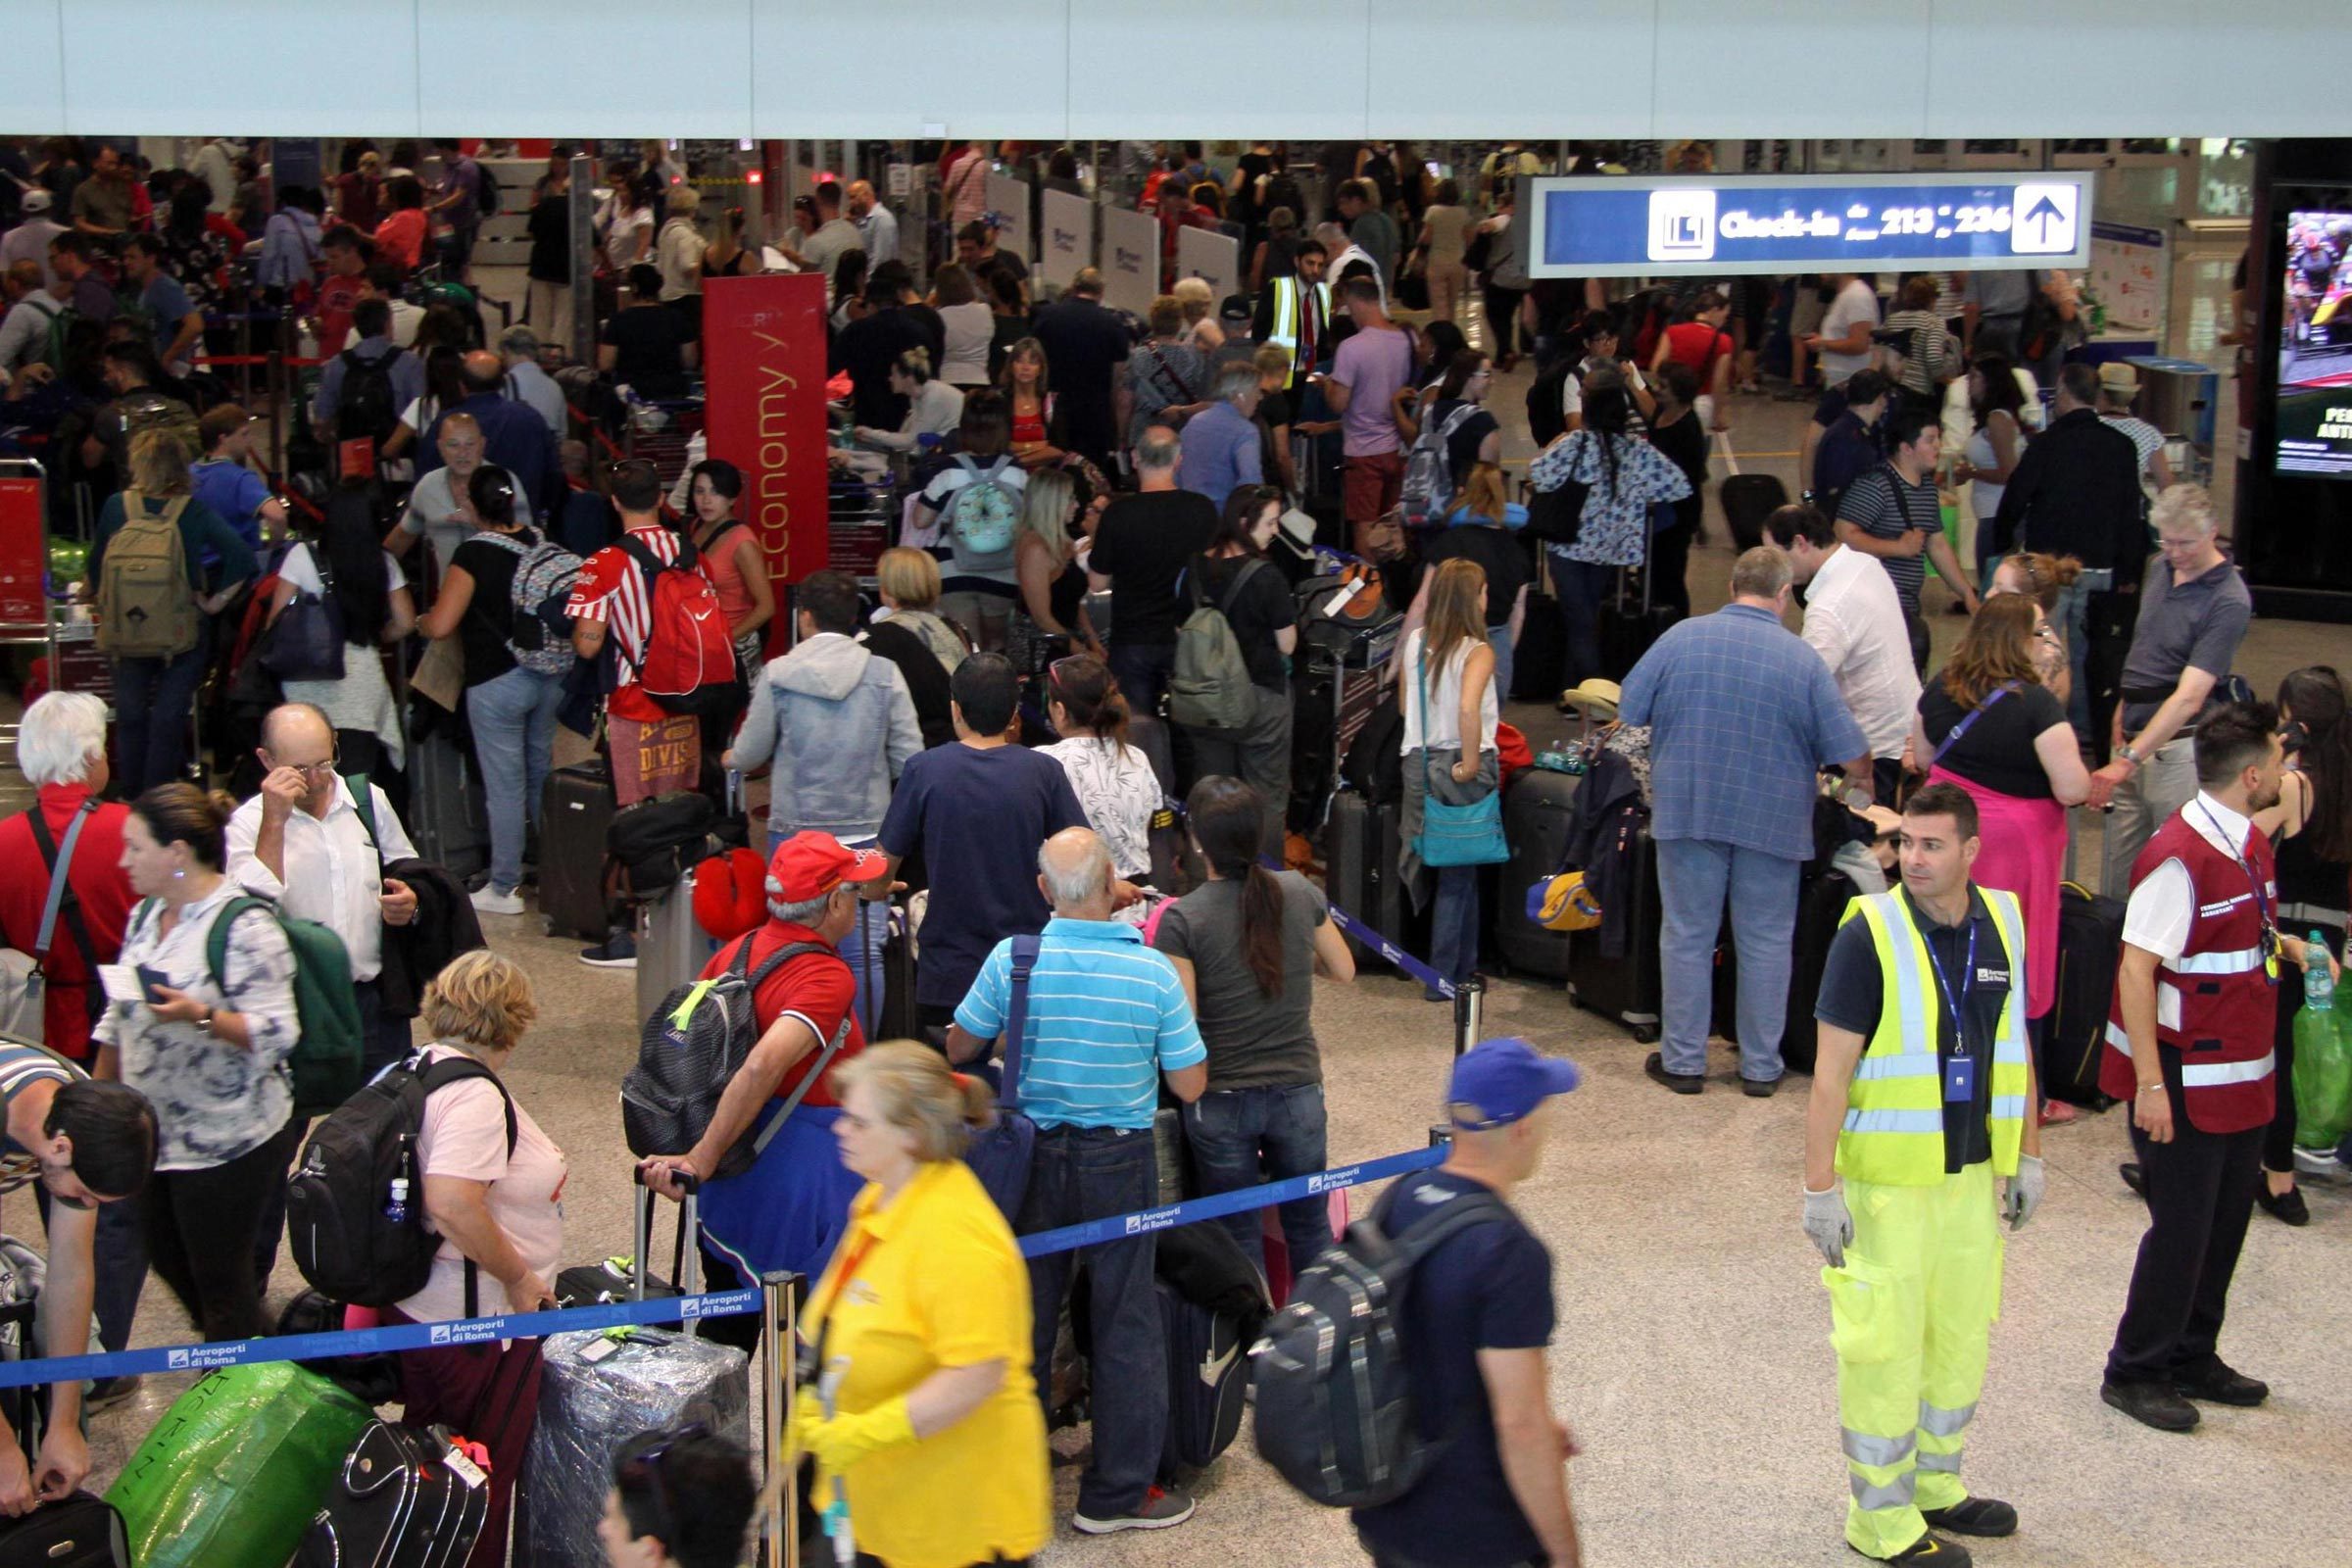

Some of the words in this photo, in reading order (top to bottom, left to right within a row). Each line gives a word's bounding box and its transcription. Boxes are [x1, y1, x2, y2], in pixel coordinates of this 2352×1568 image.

[1720, 210, 1839, 238] Check-in
[1881, 207, 1934, 234] 213
[1954, 206, 2011, 233] 236
[759, 365, 798, 580] Economy
[1142, 1206, 1181, 1222] Aeroporti
[1142, 1222, 1151, 1231] di
[1151, 1218, 1174, 1229] Roma
[701, 1292, 752, 1306] Aeroporti
[701, 1306, 711, 1315] di
[712, 1304, 743, 1313] Roma
[452, 1318, 505, 1332] Aeroporti
[452, 1334, 463, 1343] di
[465, 1331, 496, 1341] Roma
[191, 1344, 246, 1357] Aeroporti
[191, 1358, 202, 1367] di
[204, 1356, 237, 1366] Roma
